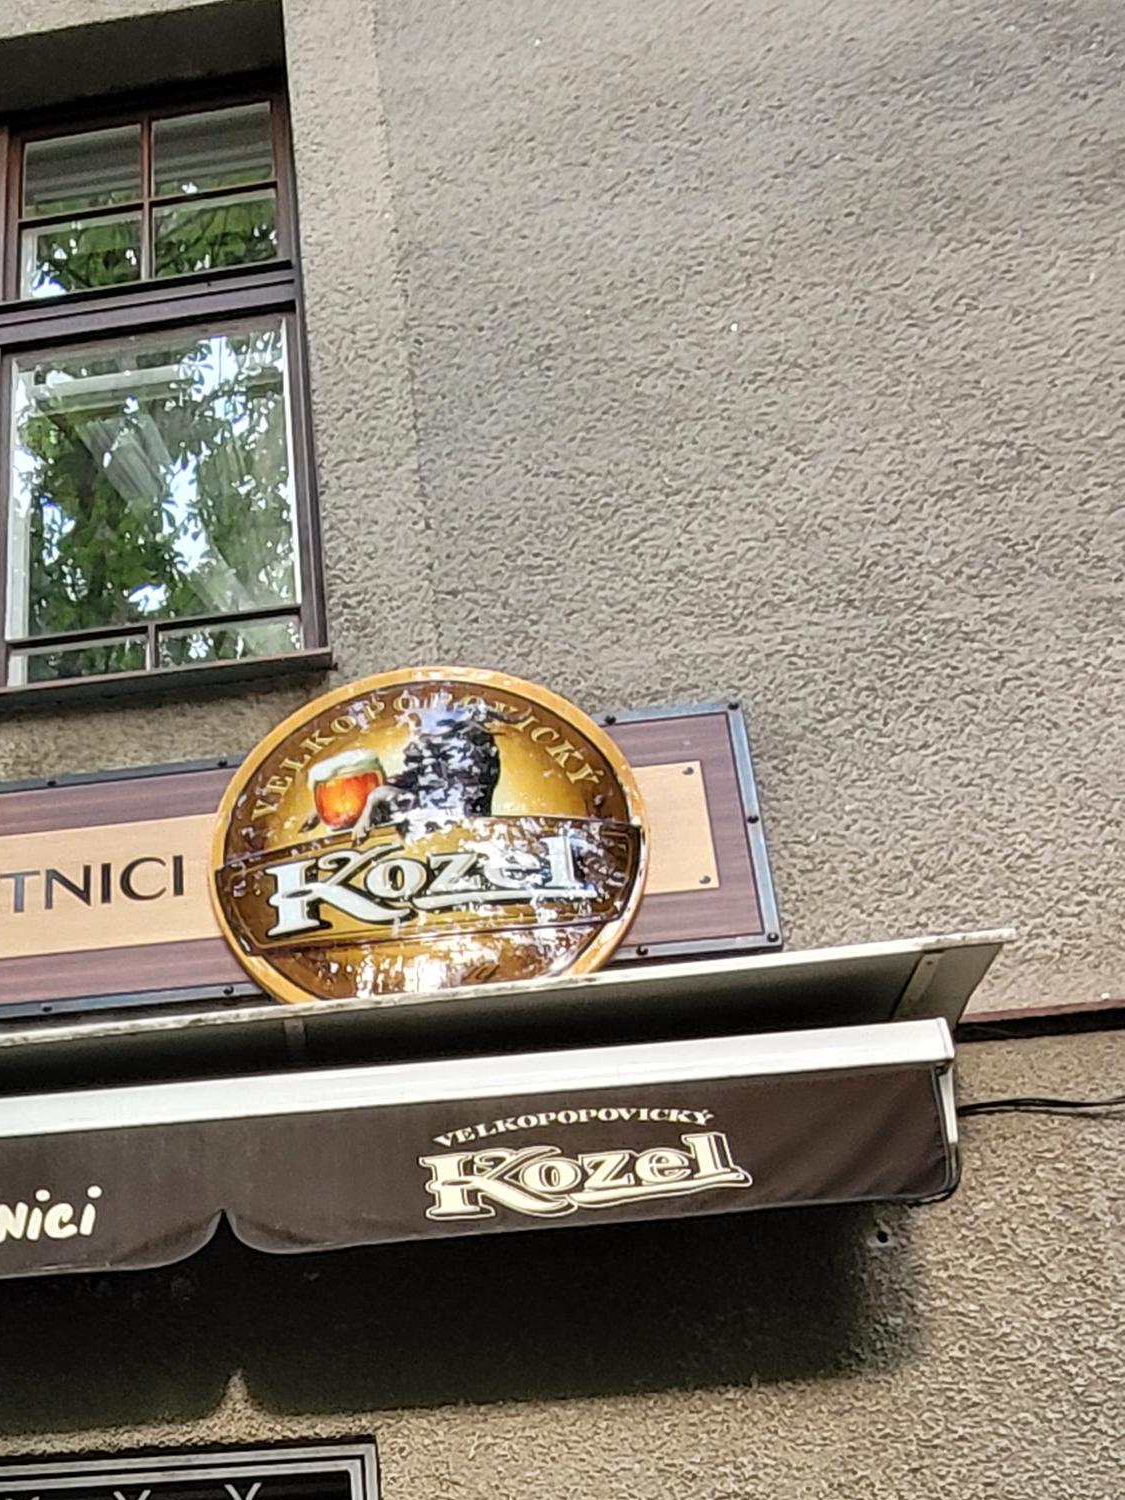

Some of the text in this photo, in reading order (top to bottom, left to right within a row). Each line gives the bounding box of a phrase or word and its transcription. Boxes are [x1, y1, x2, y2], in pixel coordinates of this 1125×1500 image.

[265, 834, 600, 938] Kozel
[432, 1107, 715, 1148] VELKOPOPOVICKÝ
[419, 1131, 753, 1221] Kozel
